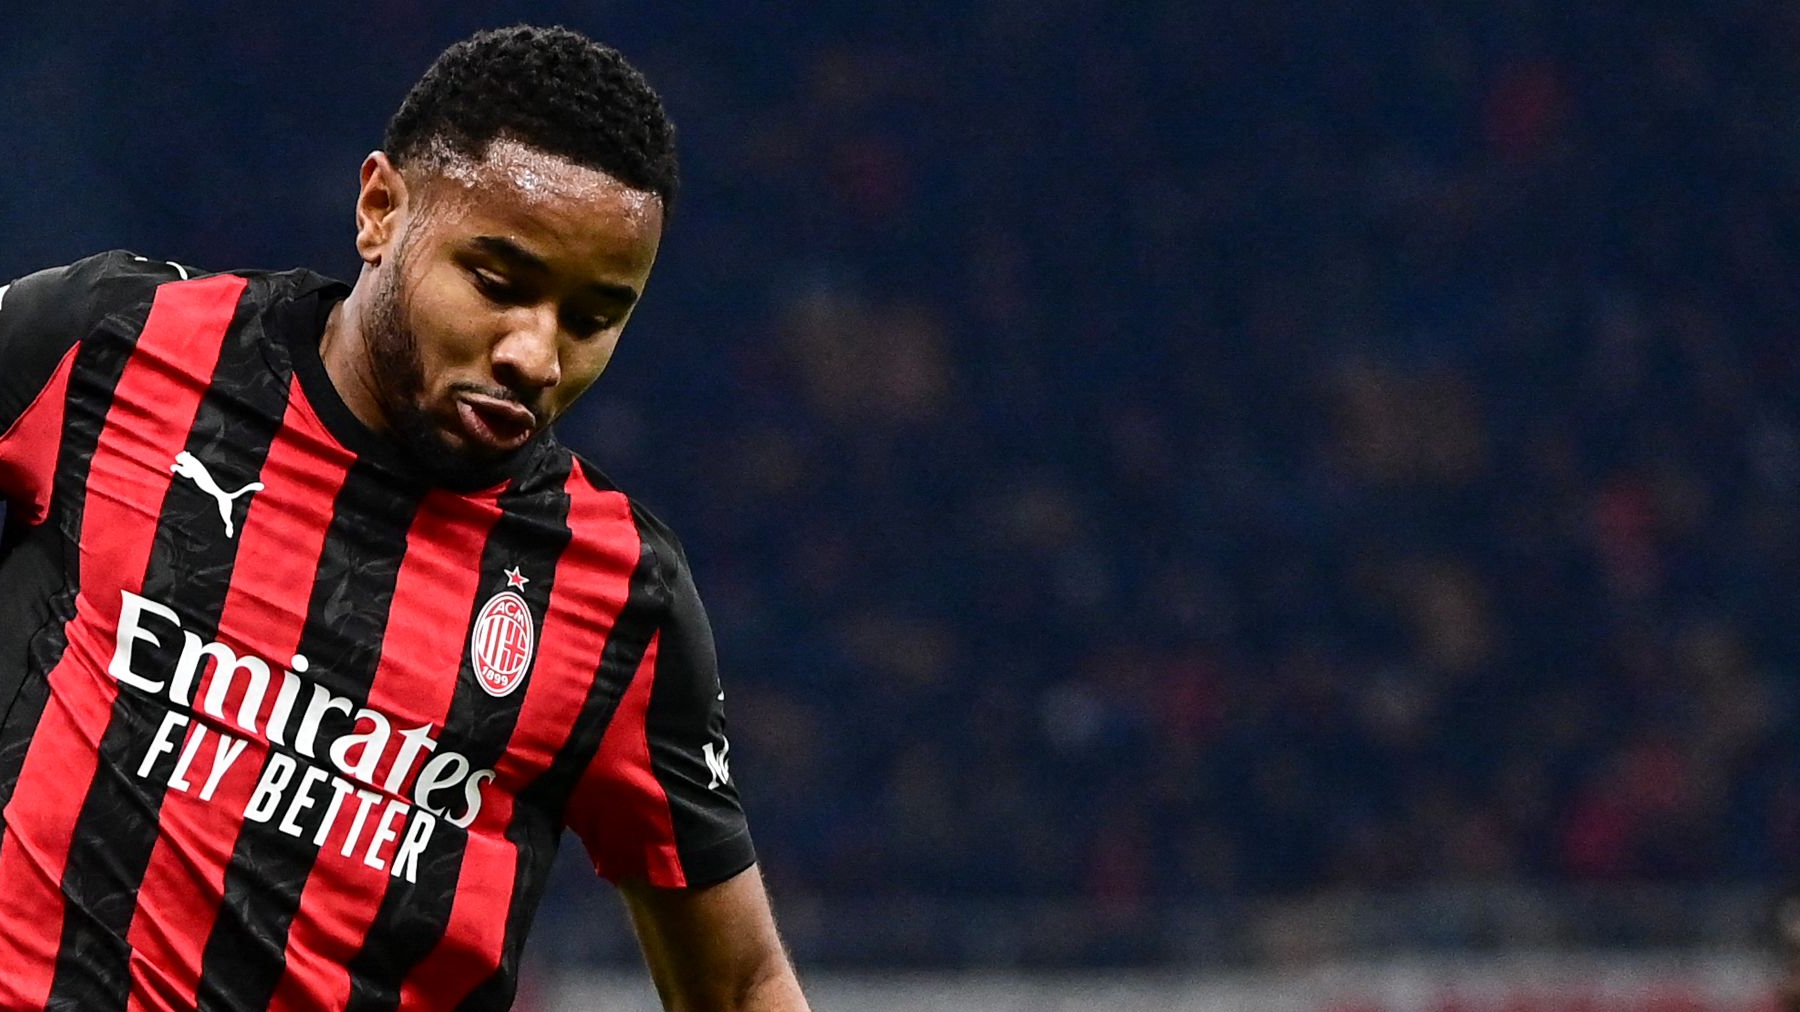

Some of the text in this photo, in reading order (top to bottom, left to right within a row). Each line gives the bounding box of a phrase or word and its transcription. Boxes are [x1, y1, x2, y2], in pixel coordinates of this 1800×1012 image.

[492, 601, 526, 628] ACM
[107, 588, 496, 829] Emirates
[481, 664, 510, 687] 1899
[137, 709, 436, 884] FLY BETTER
